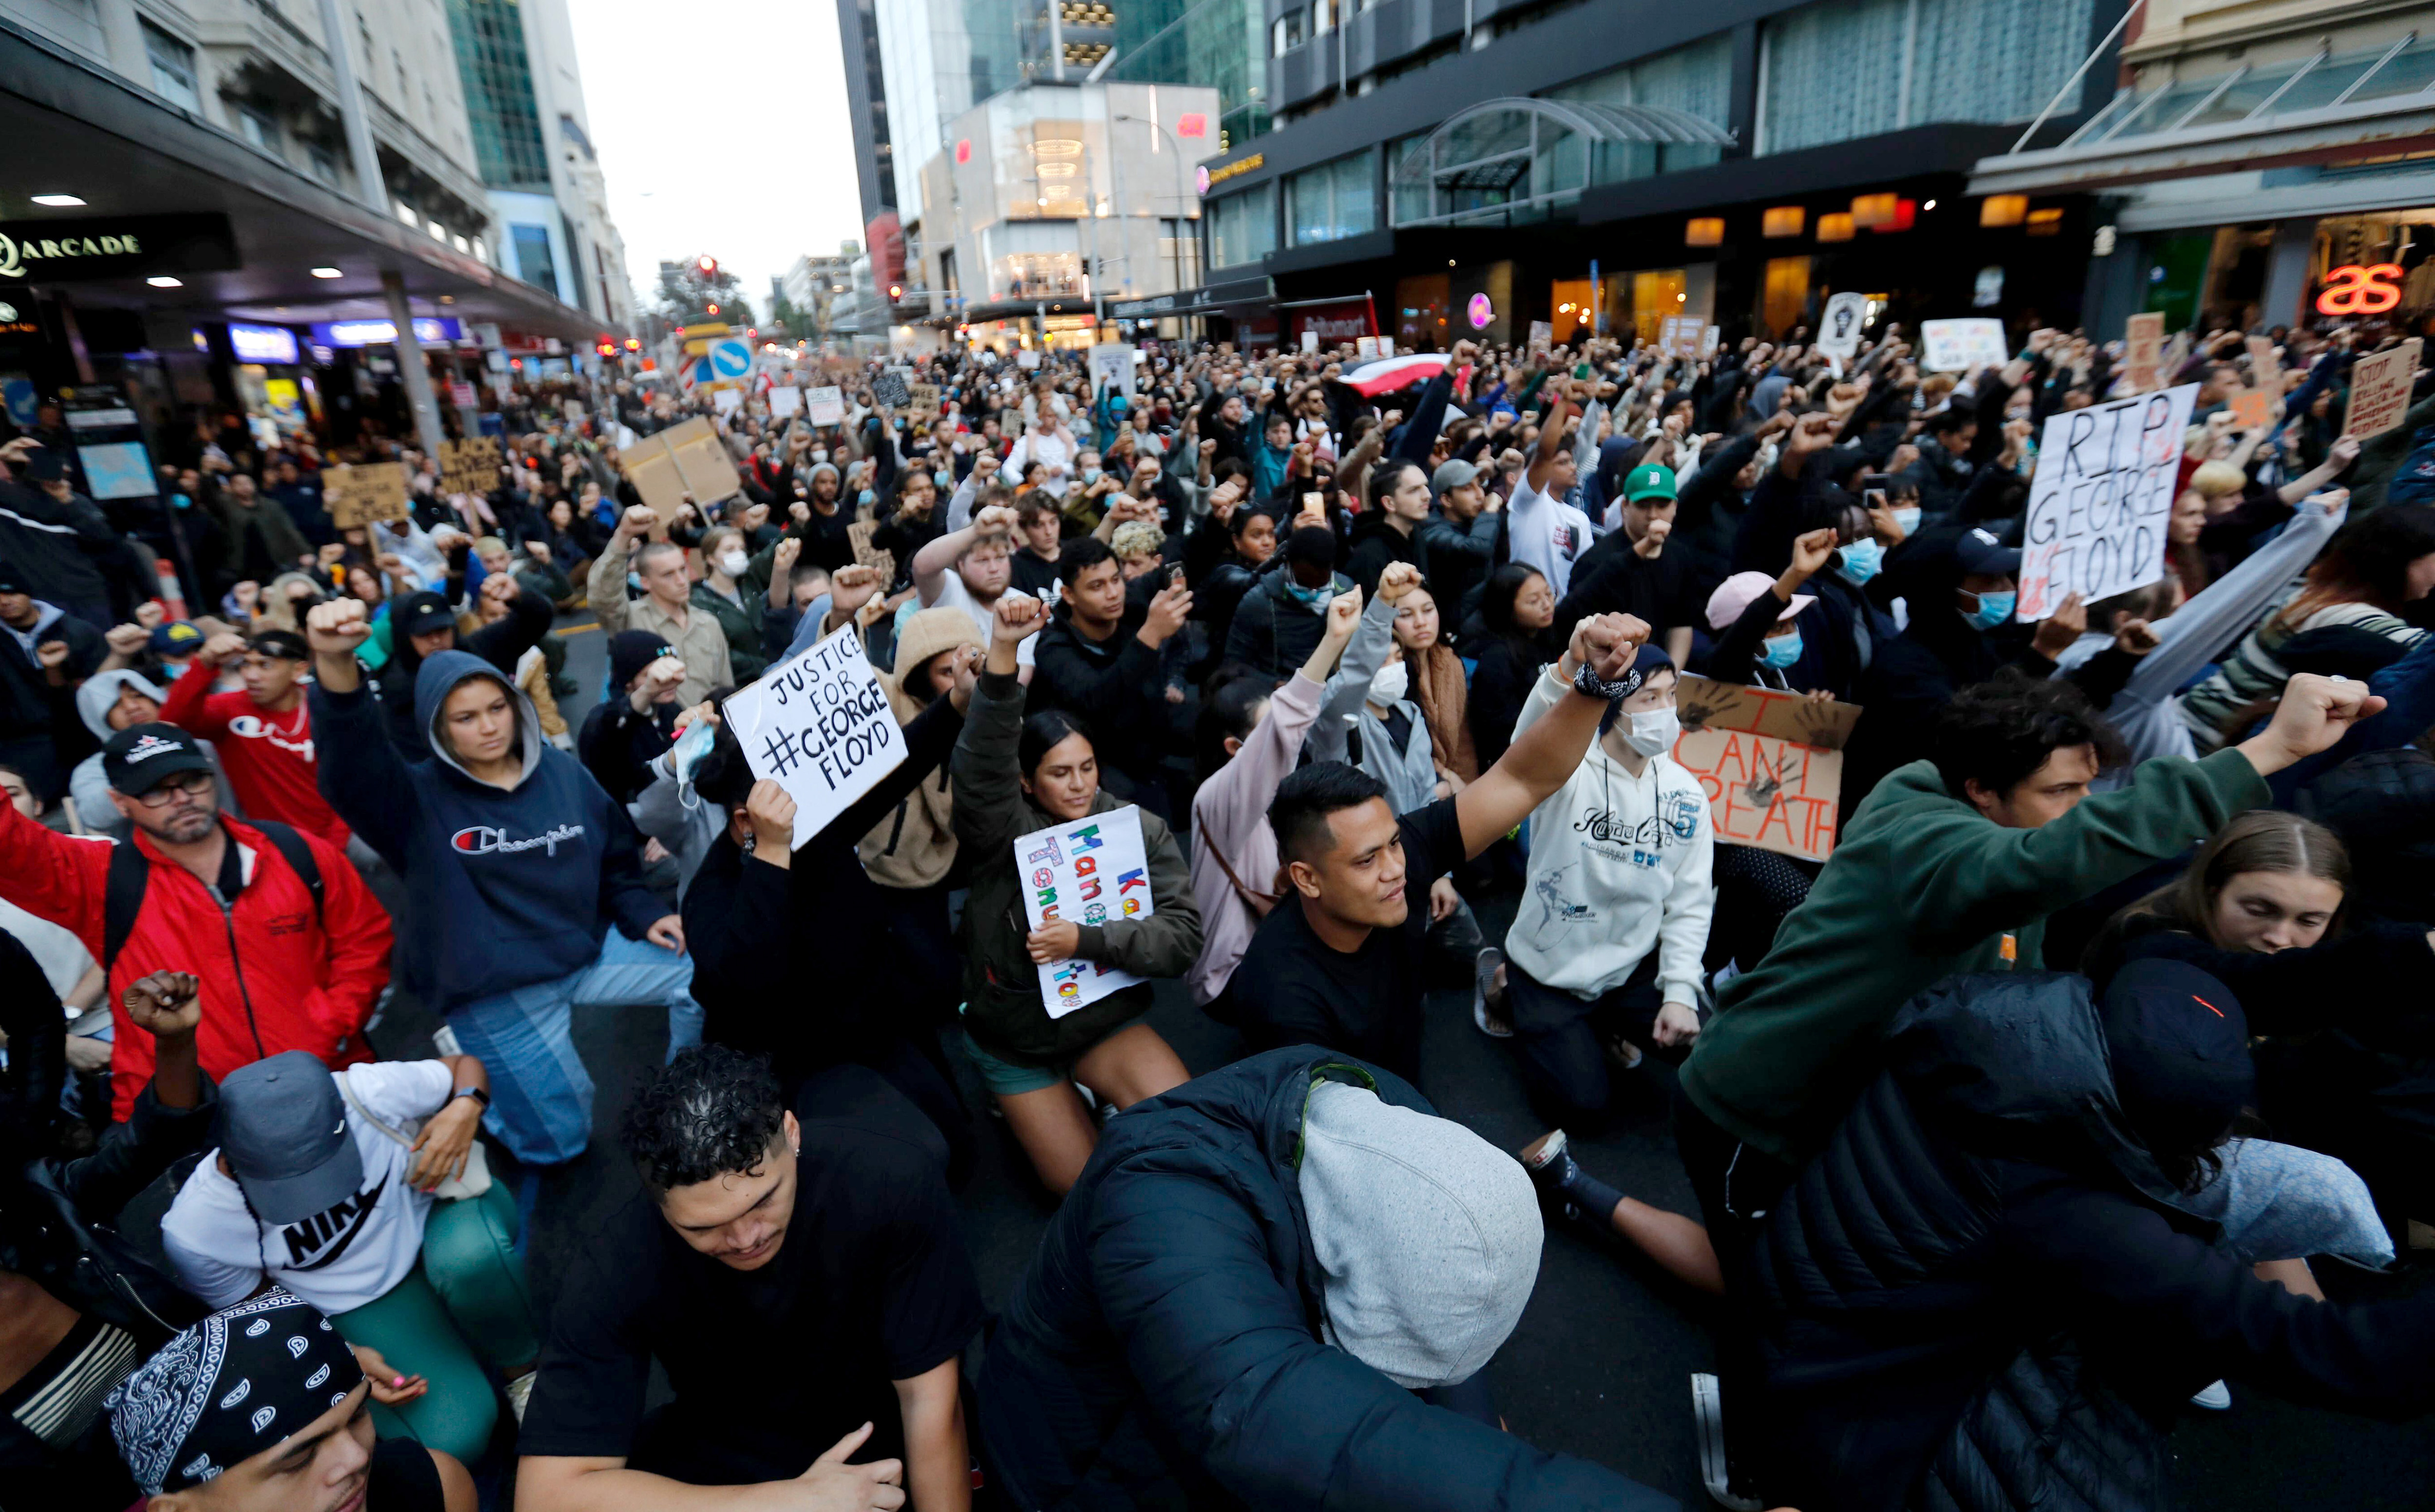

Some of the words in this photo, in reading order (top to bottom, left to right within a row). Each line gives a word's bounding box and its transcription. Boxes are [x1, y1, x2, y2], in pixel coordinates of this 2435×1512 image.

[22, 234, 142, 259] ARCADE
[2358, 357, 2392, 388] STOP
[2060, 394, 2172, 482] RIP
[2029, 459, 2175, 545] GEORGE
[770, 632, 861, 705] JUSTICE
[809, 671, 857, 716] FOR
[761, 678, 887, 777] #GEORGE
[1735, 690, 1793, 738] I
[818, 721, 889, 791] FLOYD
[1699, 774, 1839, 856] REATH
